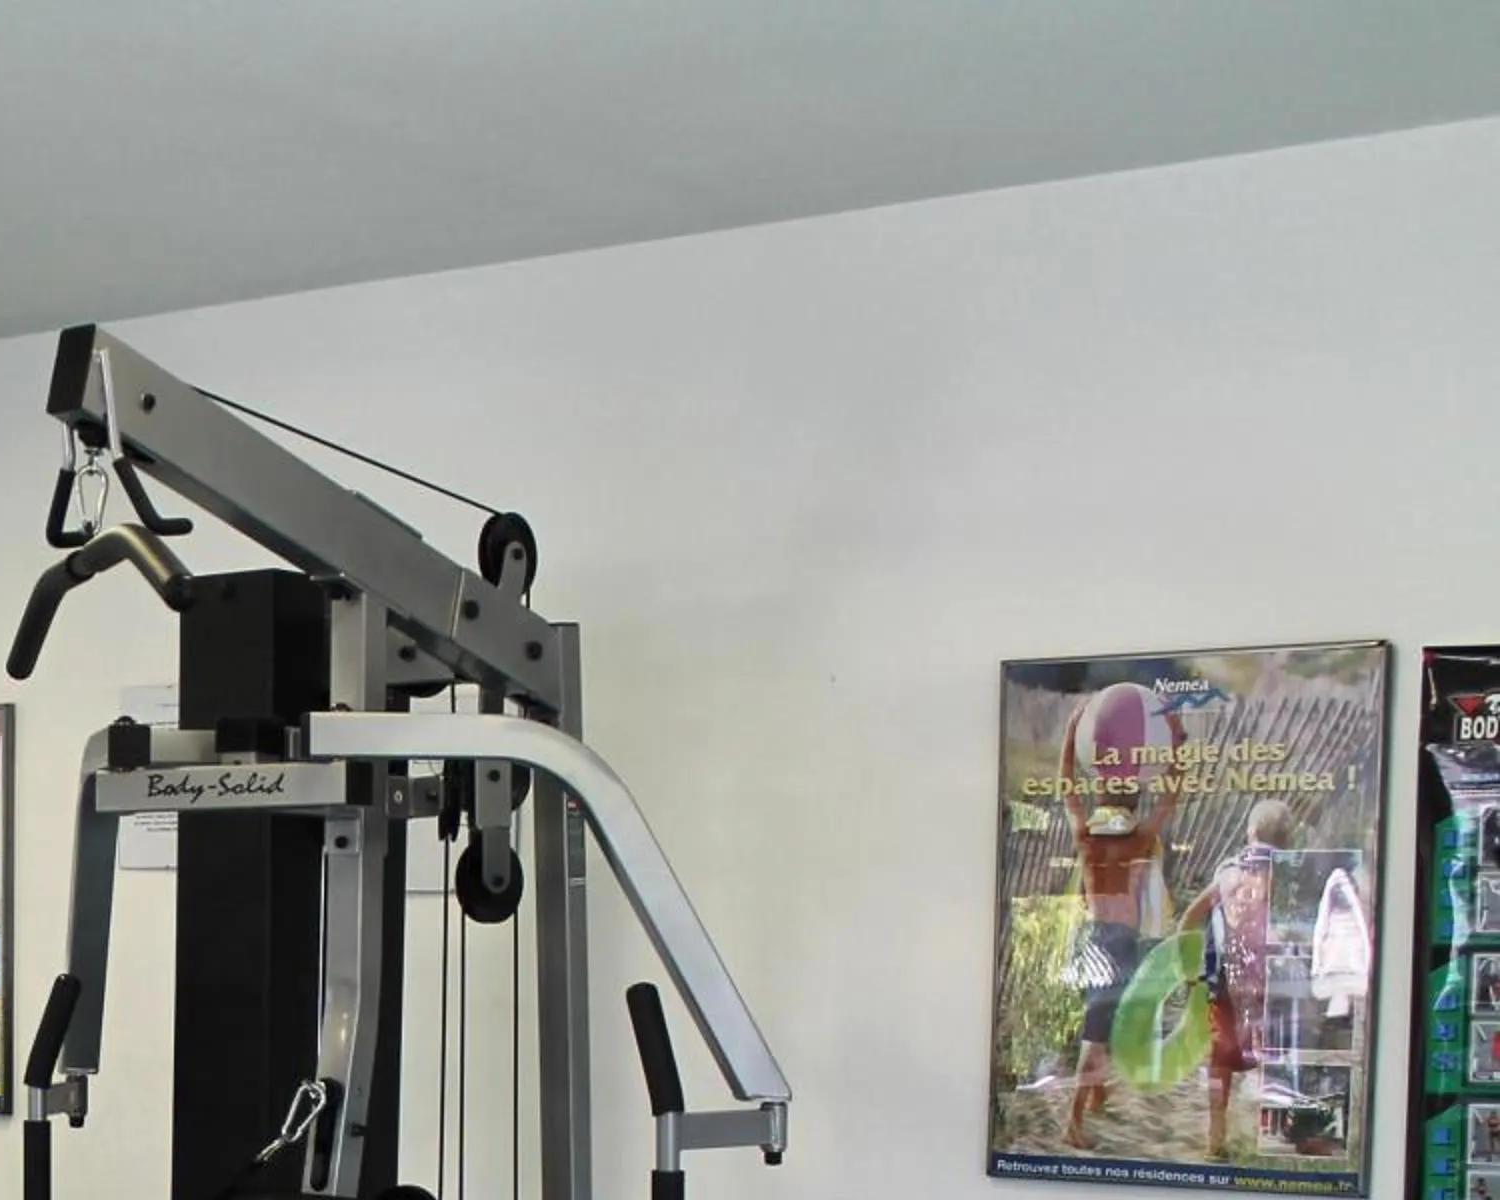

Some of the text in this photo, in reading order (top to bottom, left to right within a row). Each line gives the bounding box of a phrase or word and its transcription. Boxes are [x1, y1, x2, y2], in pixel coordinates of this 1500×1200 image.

[1153, 677, 1210, 695] Nemea
[1090, 737, 1286, 771] La magie des
[147, 771, 286, 803] Body-Solid
[1022, 764, 1356, 800] espaces avec Nemea !
